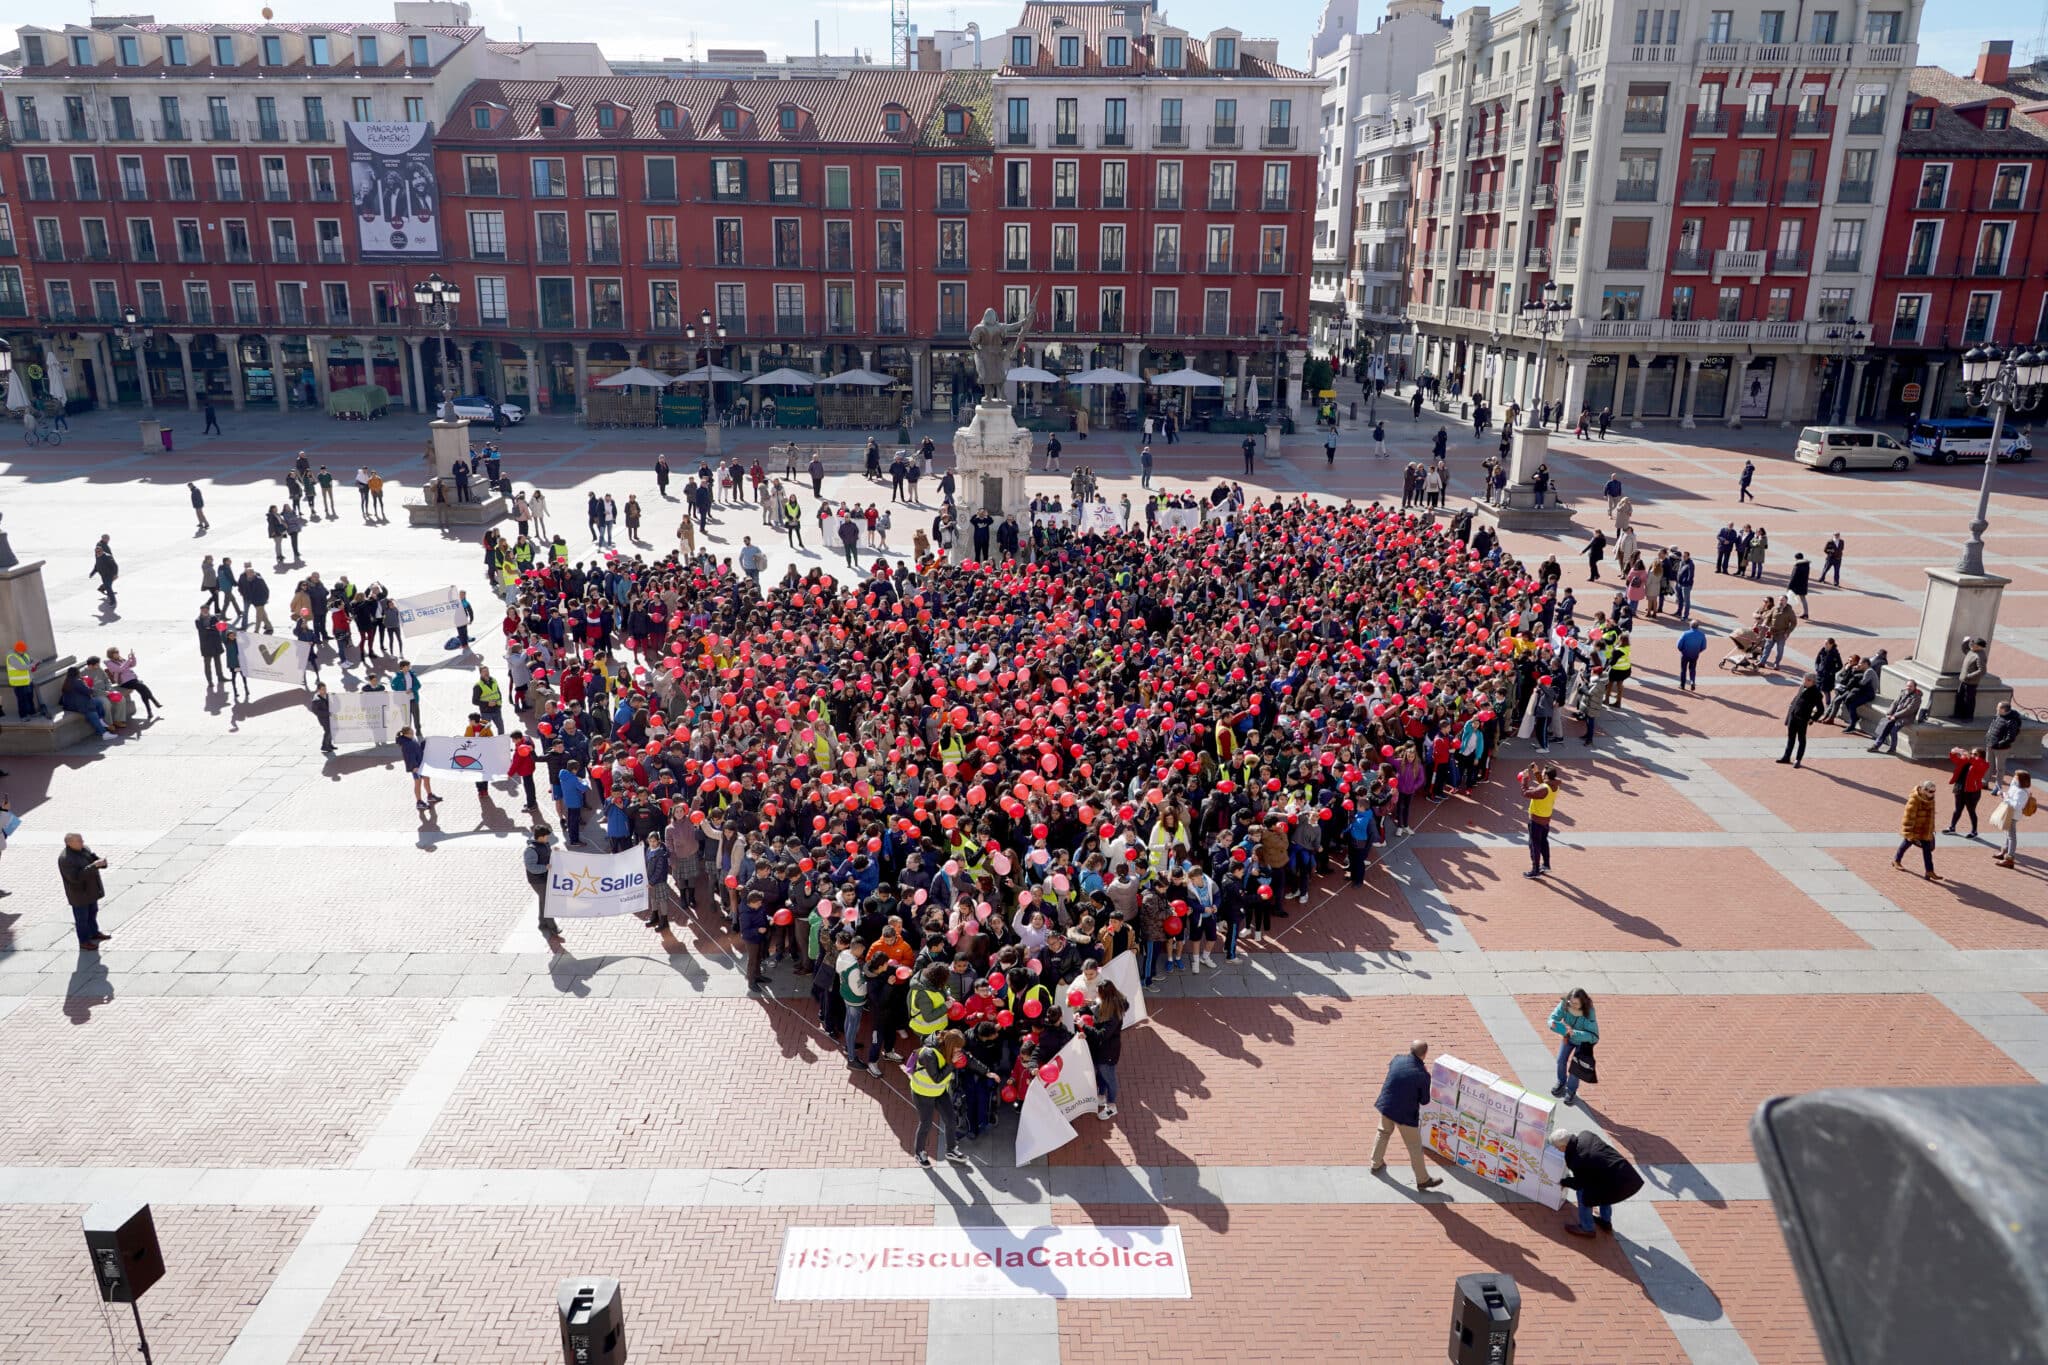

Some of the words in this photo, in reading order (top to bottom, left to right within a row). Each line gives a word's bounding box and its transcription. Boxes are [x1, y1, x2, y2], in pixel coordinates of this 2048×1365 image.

[366, 125, 409, 133] PANORAMA
[367, 134, 411, 142] FLAMENCO
[416, 607, 445, 617] CRISTO
[446, 602, 460, 611] REY
[552, 874, 573, 891] La
[600, 873, 643, 892] Salle
[1448, 1080, 1524, 1120] VALLADOLID
[788, 1245, 1174, 1273] #SoyEscuelaCatólica
